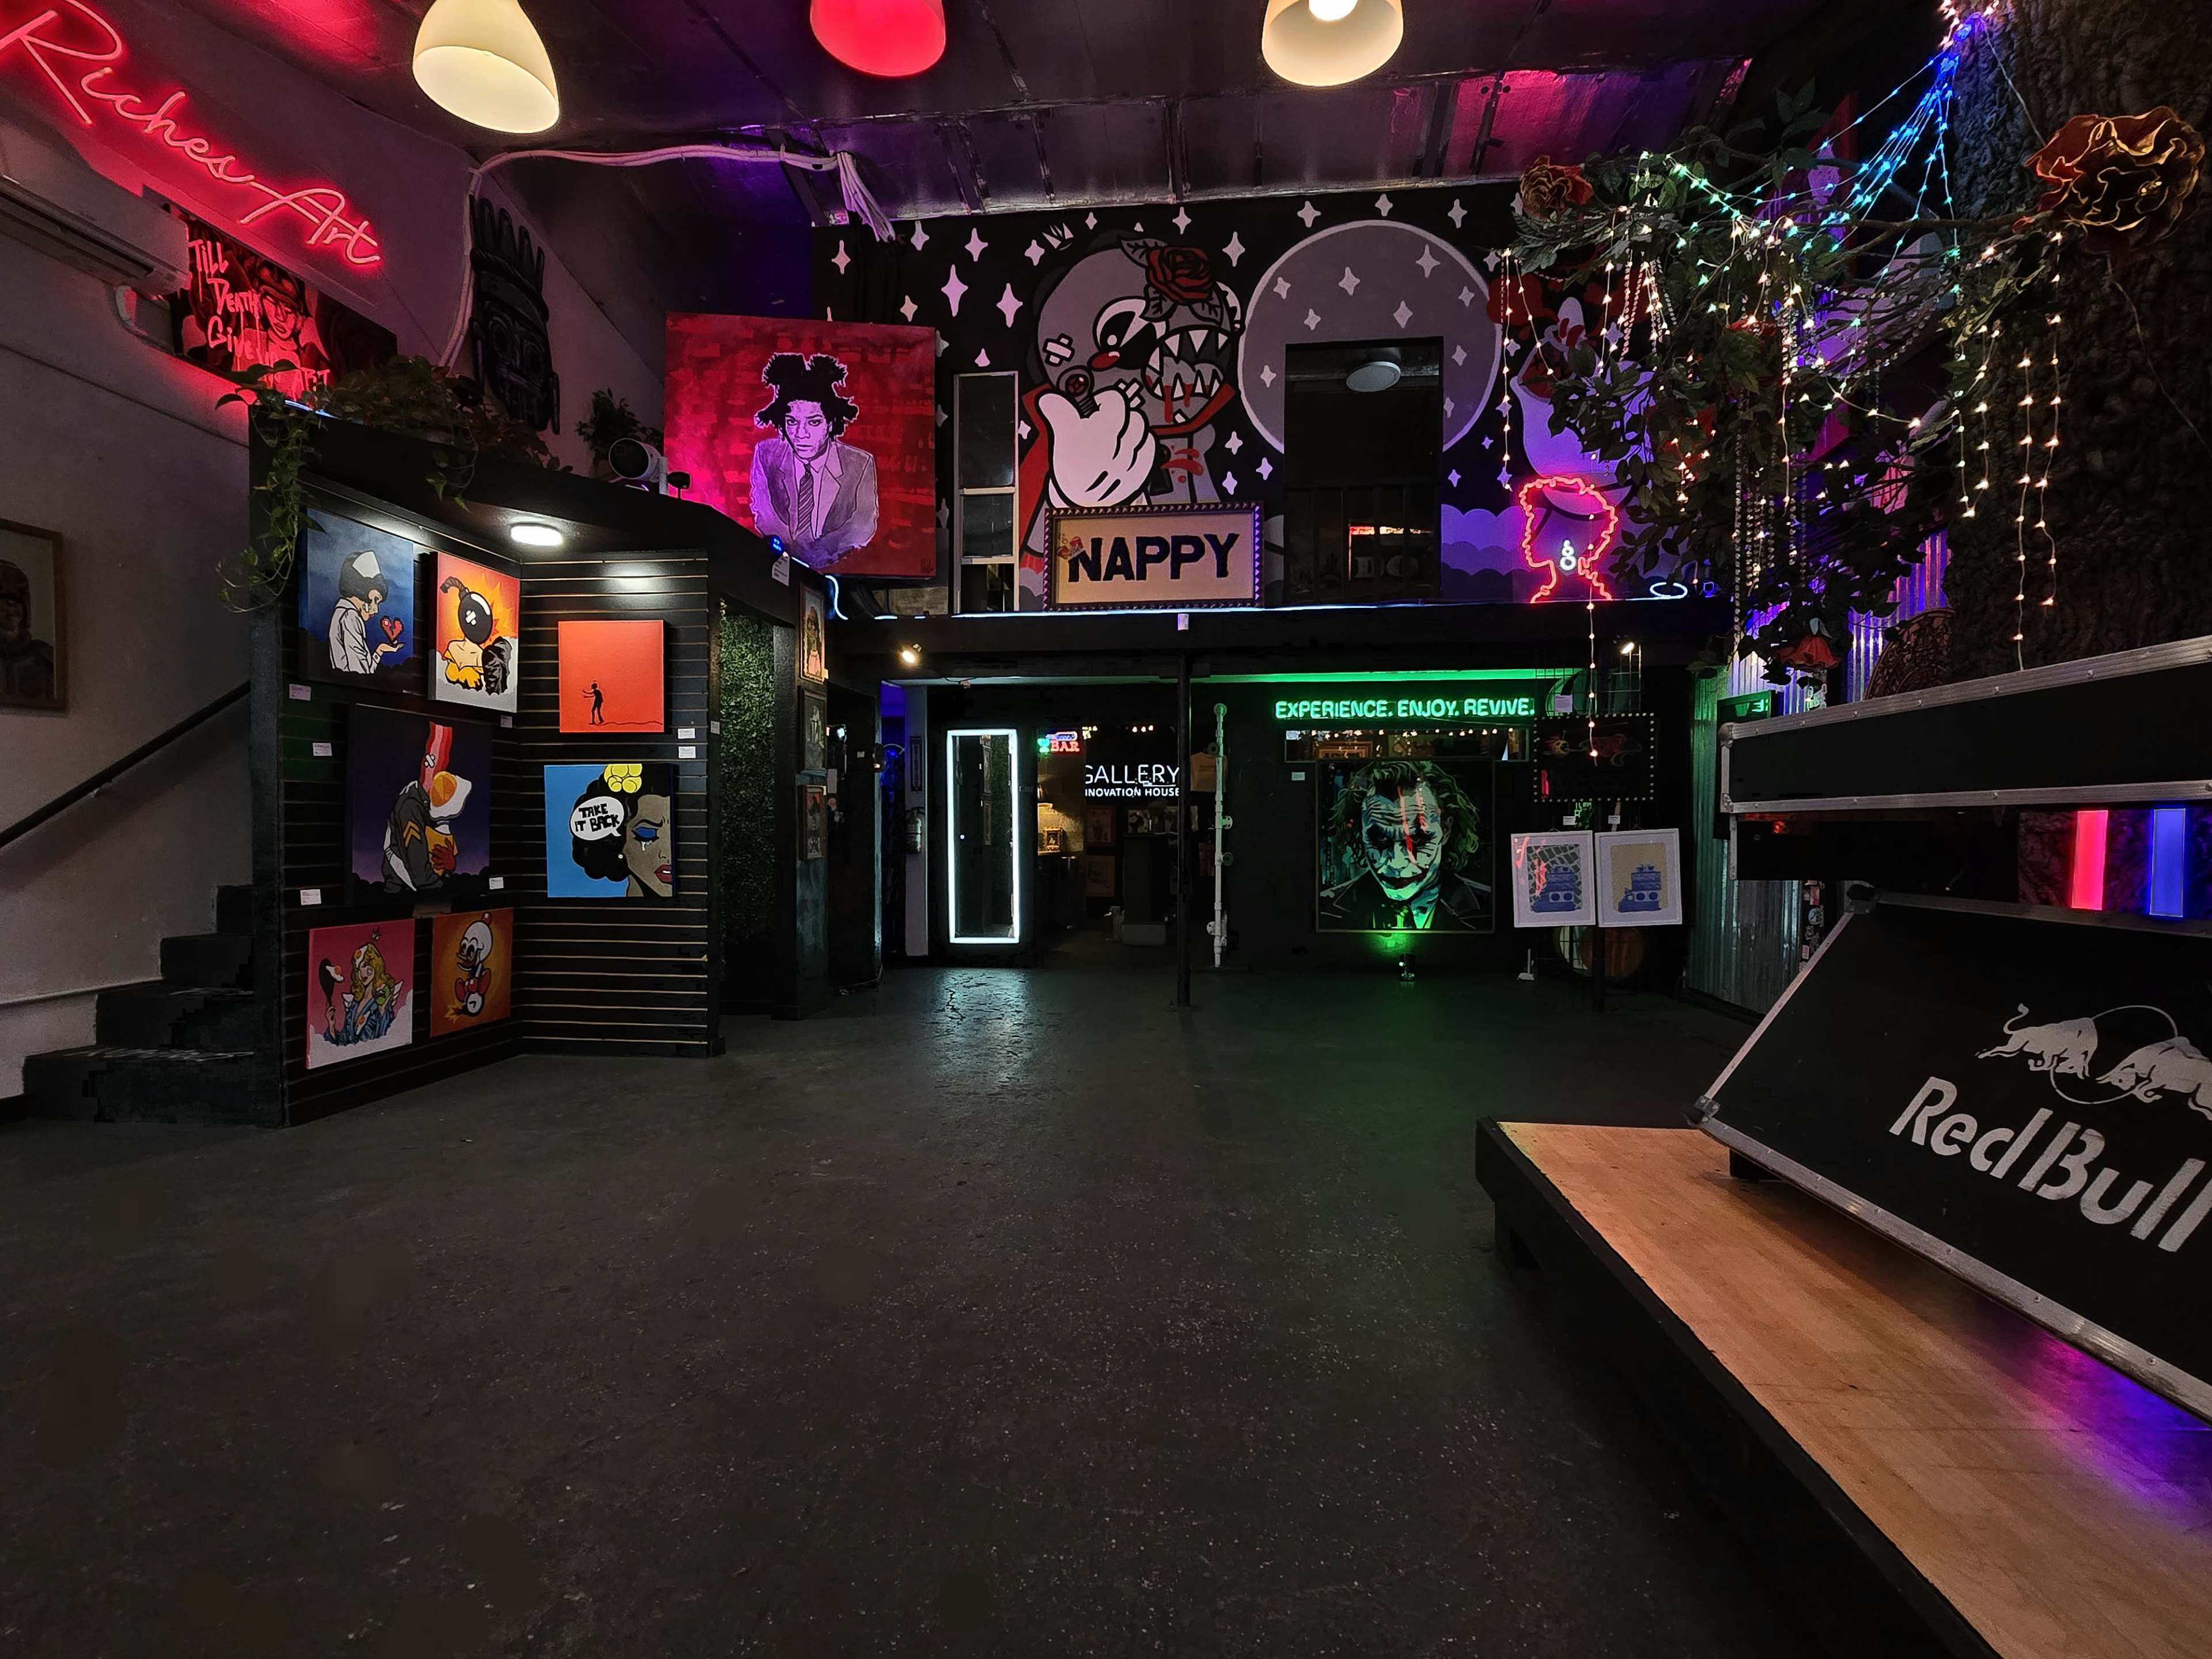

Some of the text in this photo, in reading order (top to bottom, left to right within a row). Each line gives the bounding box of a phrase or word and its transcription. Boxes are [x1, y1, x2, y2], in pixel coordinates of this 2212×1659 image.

[240, 182, 380, 264] Art
[1068, 533, 1240, 582] NAPPY
[1275, 699, 1393, 718] EXPERIENCE.
[1397, 699, 1460, 718] ENJOY.
[1464, 698, 1536, 716] REVIVE.
[1050, 740, 1080, 752] BAR
[1145, 787, 1180, 797] HOUSE
[578, 803, 608, 819] TAKE
[575, 814, 620, 832] IT BACK
[1889, 1076, 2212, 1253] Red Bull
